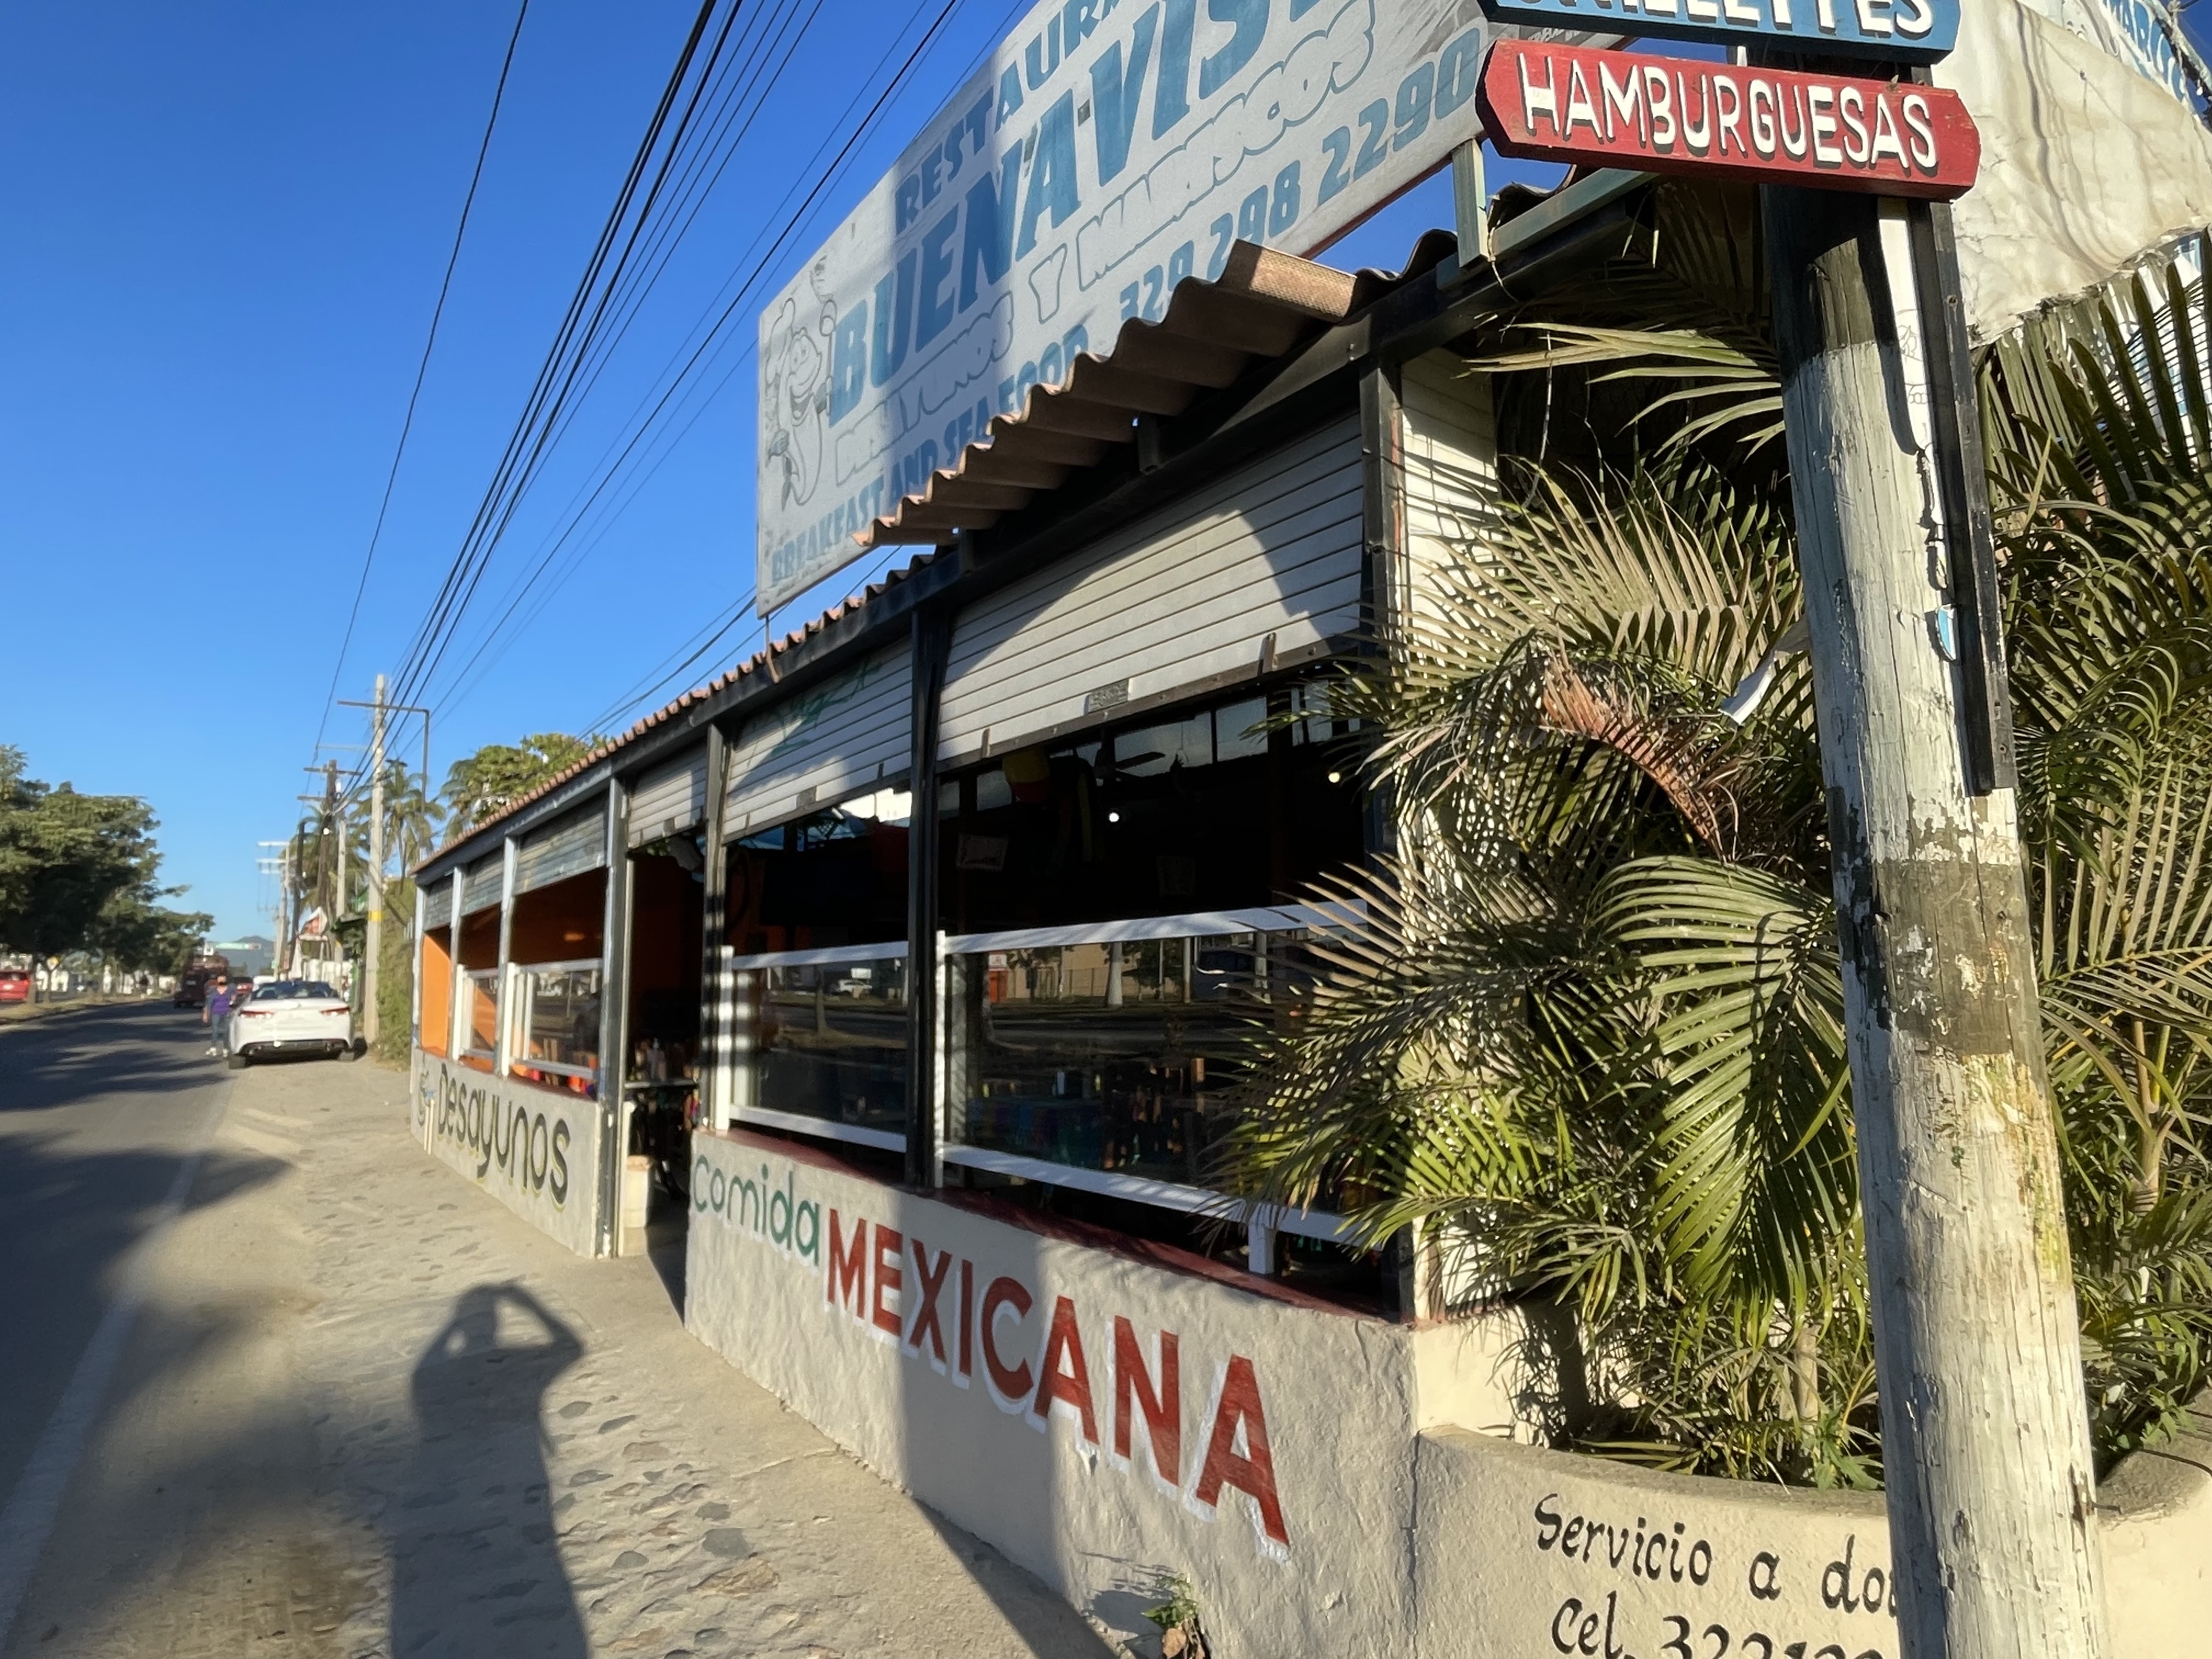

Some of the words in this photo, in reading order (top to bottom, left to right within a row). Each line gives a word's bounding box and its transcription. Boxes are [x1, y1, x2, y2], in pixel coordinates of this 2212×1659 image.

[1207, 161, 1301, 282] 298
[1319, 27, 1480, 207] 2290
[1518, 52, 1937, 173] HAMBURGUESAS
[829, 0, 1317, 428] BUENAVIS
[1029, 243, 1068, 324] Y
[771, 475, 884, 583] BREAKFAST
[890, 439, 938, 508] AND
[438, 1062, 571, 1207] Desayunos
[693, 1155, 819, 1267] Comida
[826, 1209, 1290, 1550] MEXICANA
[1534, 1493, 1712, 1586] Servicio
[1749, 1551, 1782, 1601] a
[1821, 1533, 1898, 1618] do
